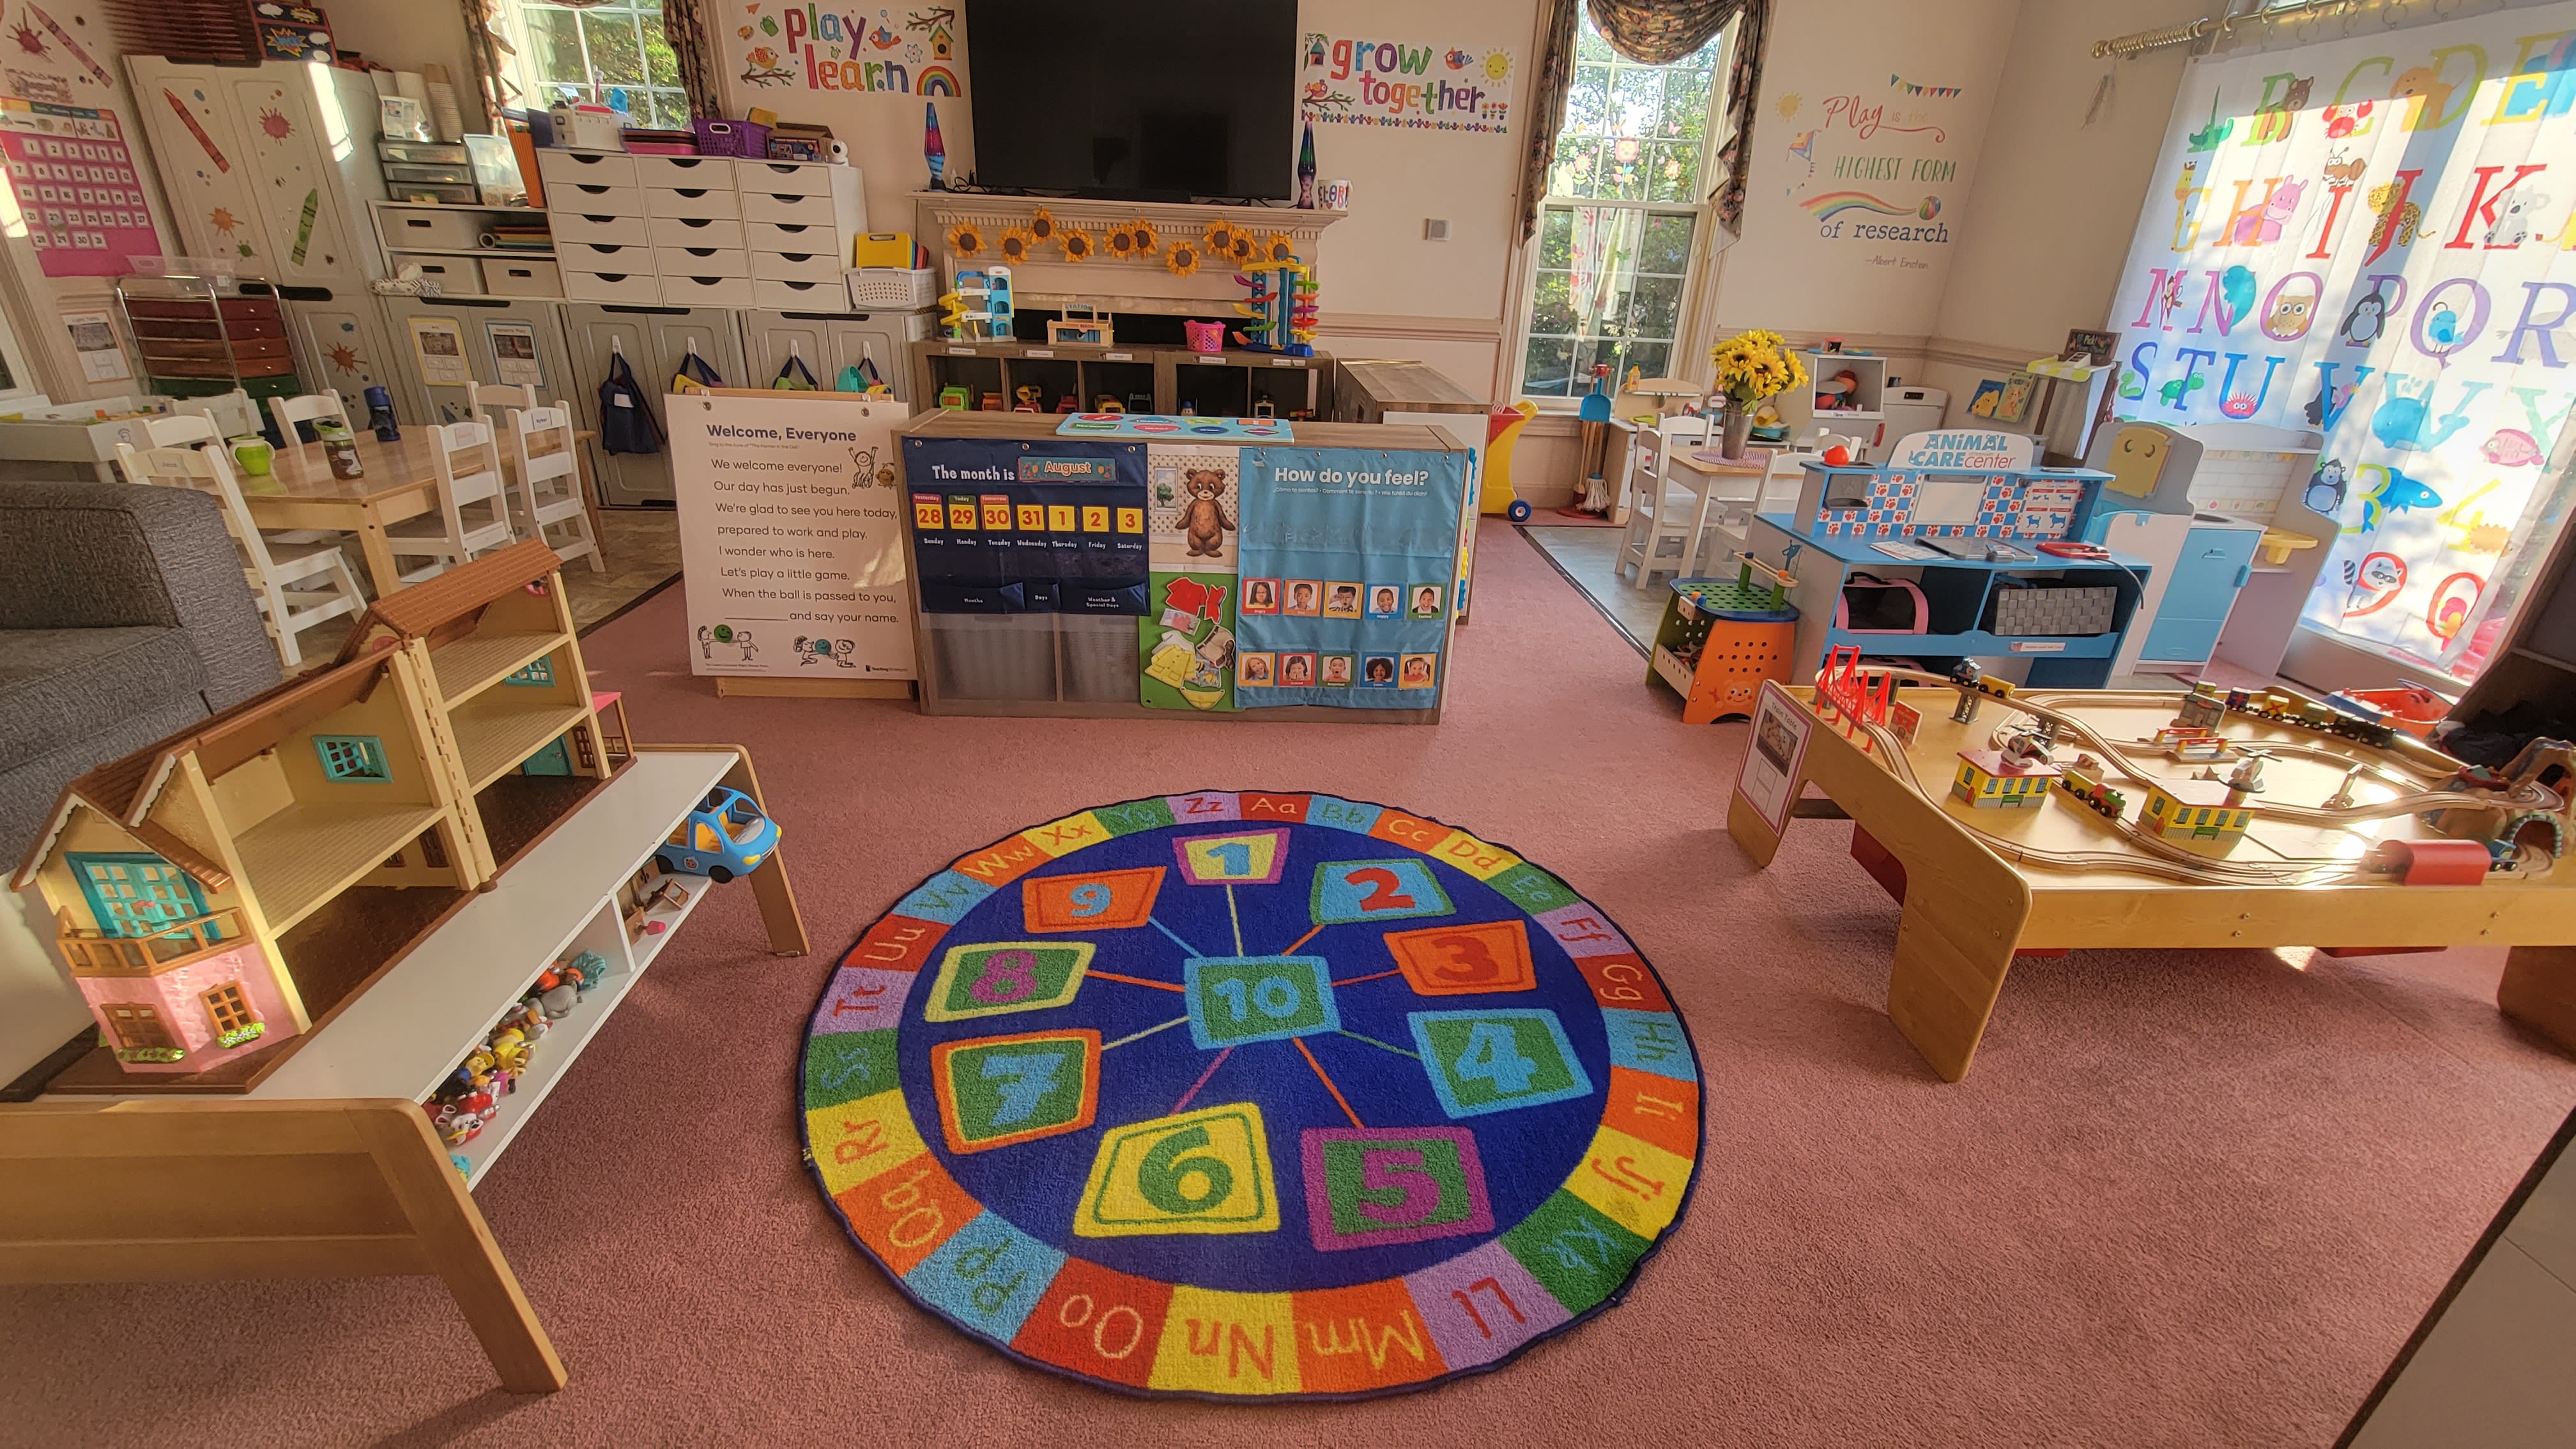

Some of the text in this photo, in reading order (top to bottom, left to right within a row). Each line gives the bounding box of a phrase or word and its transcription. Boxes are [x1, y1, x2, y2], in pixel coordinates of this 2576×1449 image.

[784, 3, 866, 61] play
[804, 43, 909, 93] learn
[1330, 40, 1432, 80] grow
[1359, 70, 1485, 114] together
[2241, 72, 2297, 146] B
[2331, 57, 2394, 137] C
[2412, 43, 2487, 132] D
[2480, 31, 2576, 125] E
[1909, 112, 1928, 121] the
[1834, 156, 1956, 182] HIGHEST FORM
[2171, 164, 2547, 266] G H I J K
[1821, 221, 1948, 243] of research
[1900, 257, 1928, 269] Einstein
[2131, 269, 2576, 370] M N O P Q R
[2128, 342, 2158, 401] S
[2174, 348, 2216, 411] T
[2218, 353, 2285, 419] U
[2313, 362, 2375, 433] V
[707, 425, 856, 443] Welcome, Everyone
[2511, 387, 2576, 473] X
[711, 459, 842, 474] We welcome everyone!
[932, 464, 1015, 480] The month is
[1045, 461, 1091, 477] August
[1913, 451, 2016, 469] CARE center
[714, 481, 850, 496] Our day has just begun.
[1275, 468, 1429, 487] How do you feel?
[716, 503, 746, 512] We're
[749, 504, 774, 515] glad
[778, 505, 788, 514] to
[813, 509, 833, 518] you
[837, 507, 861, 517] here
[864, 509, 897, 519] today,
[918, 509, 1135, 528] 28 29 30 31 1 2 3
[2340, 463, 2501, 552] 3 4
[717, 526, 867, 540] prepared to work and play.
[956, 538, 977, 546] Monday
[1017, 540, 1046, 548] Wednesday
[1052, 540, 1077, 549] Thursday
[719, 546, 834, 558] I wonder who is here.
[721, 567, 746, 576] Let's
[750, 568, 773, 579] play
[788, 569, 811, 579] little
[815, 571, 850, 581] game.
[2343, 551, 2407, 618] 9
[722, 588, 896, 603] When the ball is passed to you,
[790, 611, 899, 623] and say your name.
[1772, 702, 1798, 730] Train Table
[1184, 797, 1223, 814] Zz
[1250, 797, 1298, 815] Aa
[1321, 803, 1366, 824] Bb
[1040, 825, 1092, 847] Xx
[1388, 820, 1429, 842] Cc
[963, 845, 1036, 878] Ww
[1206, 842, 1251, 875] 1
[1448, 840, 1502, 870] Dd
[912, 883, 970, 910] Vv
[1070, 883, 1112, 917] 9
[1344, 867, 1415, 912] 2
[1511, 875, 1552, 902] Ee
[864, 926, 926, 962] Uu
[1558, 917, 1613, 942] Ff
[1433, 935, 1499, 983] 3
[970, 949, 1038, 1003] 8
[1599, 964, 1644, 1001] Gg
[832, 984, 887, 1017] Tt
[1213, 976, 1301, 1023] 10
[1455, 1022, 1538, 1093] 4
[1634, 1020, 1677, 1063] Hh
[820, 1046, 870, 1088] Ss
[981, 1053, 1066, 1127] 7
[1634, 1091, 1684, 1121] Ii
[835, 1119, 891, 1165] Rr
[1137, 1125, 1234, 1215] 6
[1358, 1149, 1441, 1223] 5
[1591, 1155, 1665, 1202] Jj
[880, 1167, 944, 1248] Qq
[1541, 1218, 1621, 1275] Kk
[954, 1238, 1027, 1316] Pp
[1452, 1276, 1526, 1339] Ll
[1060, 1294, 1143, 1359] Oo
[1304, 1309, 1425, 1369] Mm
[1186, 1318, 1274, 1381] Nn
